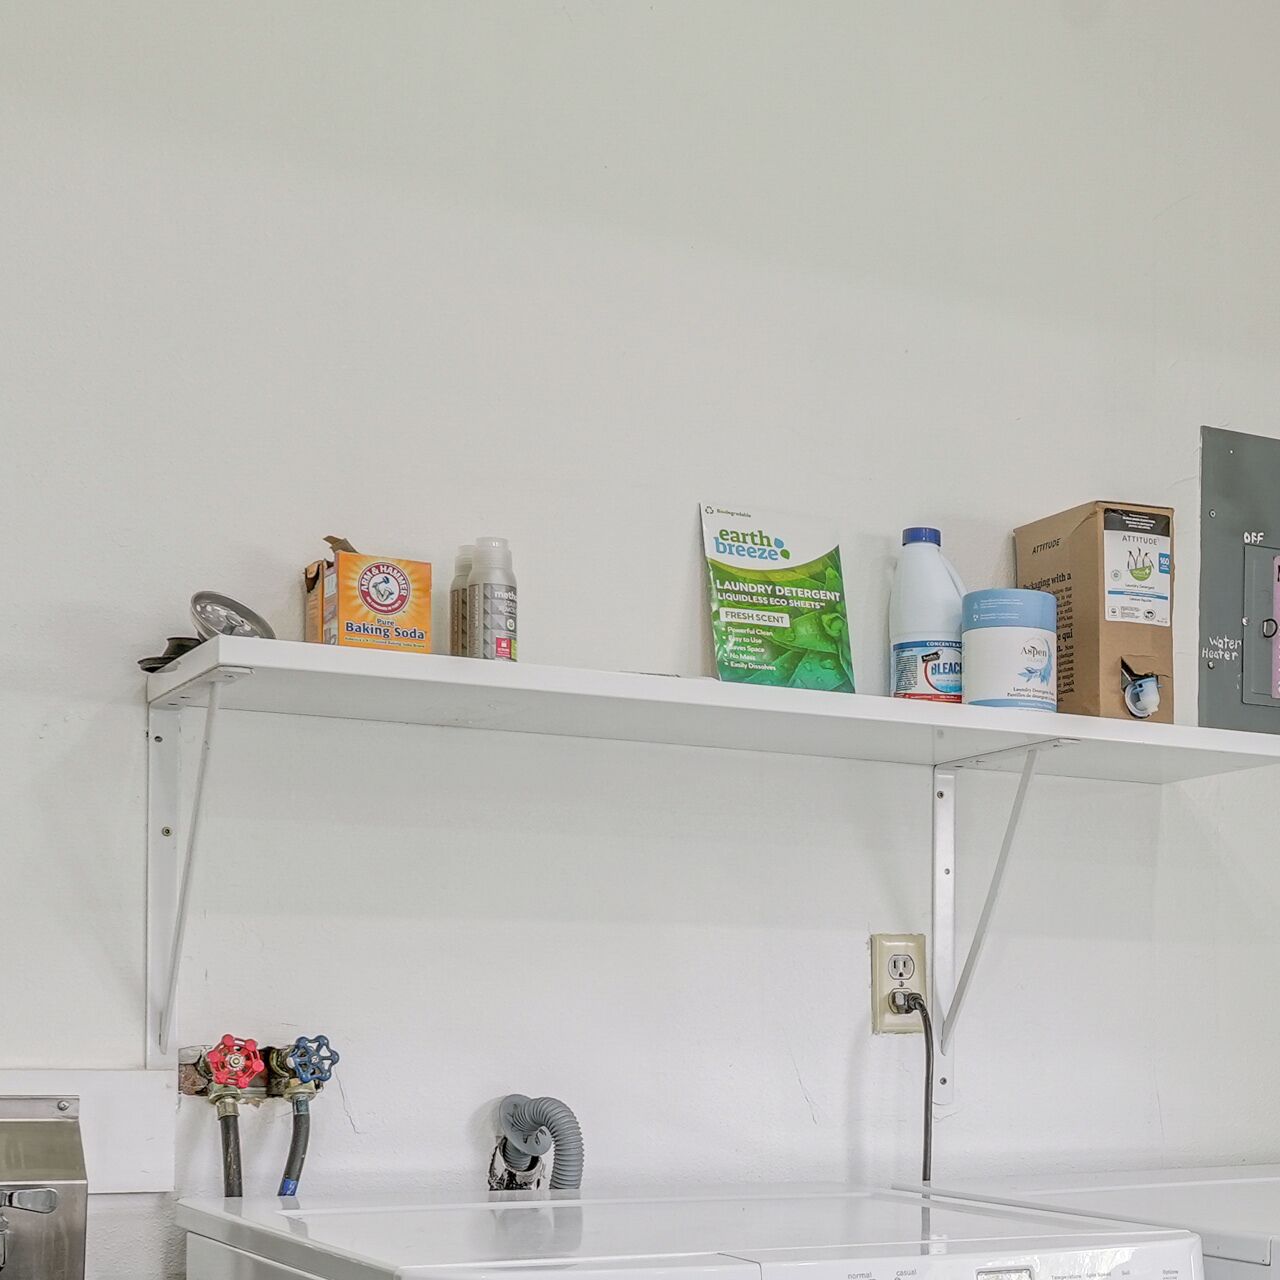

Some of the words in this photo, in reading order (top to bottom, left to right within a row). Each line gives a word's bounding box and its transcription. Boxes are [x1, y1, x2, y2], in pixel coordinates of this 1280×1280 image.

[719, 529, 773, 548] earth
[1122, 535, 1158, 546] ATTITUDE
[1244, 532, 1264, 544] OFF
[713, 537, 779, 561] breeze
[1032, 538, 1061, 555] ATTITUDE
[361, 570, 373, 592] ARM
[380, 564, 408, 596] HAMMER
[1051, 573, 1066, 584] with
[716, 579, 773, 596] LAUNDRY
[775, 586, 840, 602] DETERGENT
[718, 592, 769, 606] LIQUIDLESS
[769, 598, 787, 607] ECO
[377, 618, 395, 627] Pure
[725, 611, 754, 621] FRESH
[755, 614, 785, 624] SCENT
[346, 622, 390, 638] Baking
[394, 627, 425, 641] Soda
[728, 626, 755, 635] Powerful
[1209, 636, 1242, 650] Water
[1021, 645, 1047, 658] Aspen
[1202, 647, 1239, 661] Heater
[847, 1272, 872, 1280] normal
[896, 1269, 917, 1277] casual
